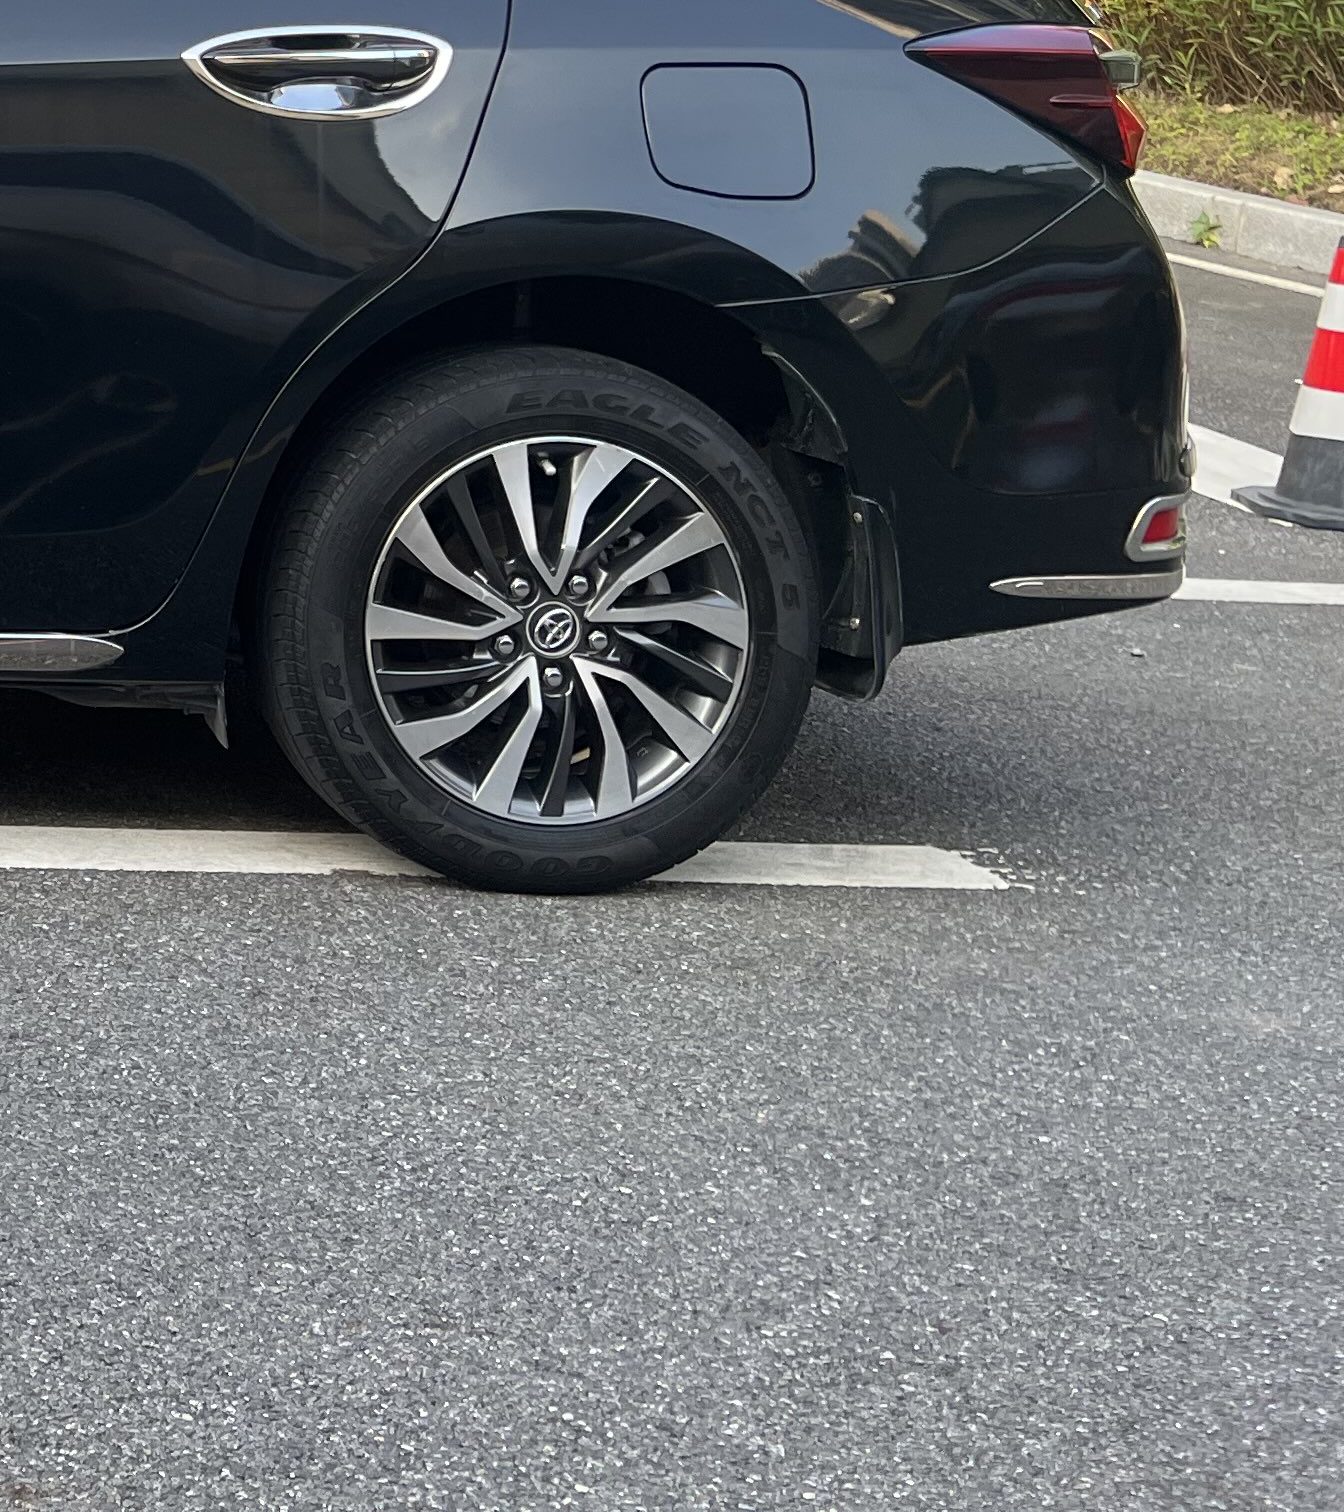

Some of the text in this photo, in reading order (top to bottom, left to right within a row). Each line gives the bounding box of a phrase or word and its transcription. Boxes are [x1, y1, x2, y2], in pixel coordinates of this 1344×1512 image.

[506, 389, 801, 610] EAGLE NCT 5
